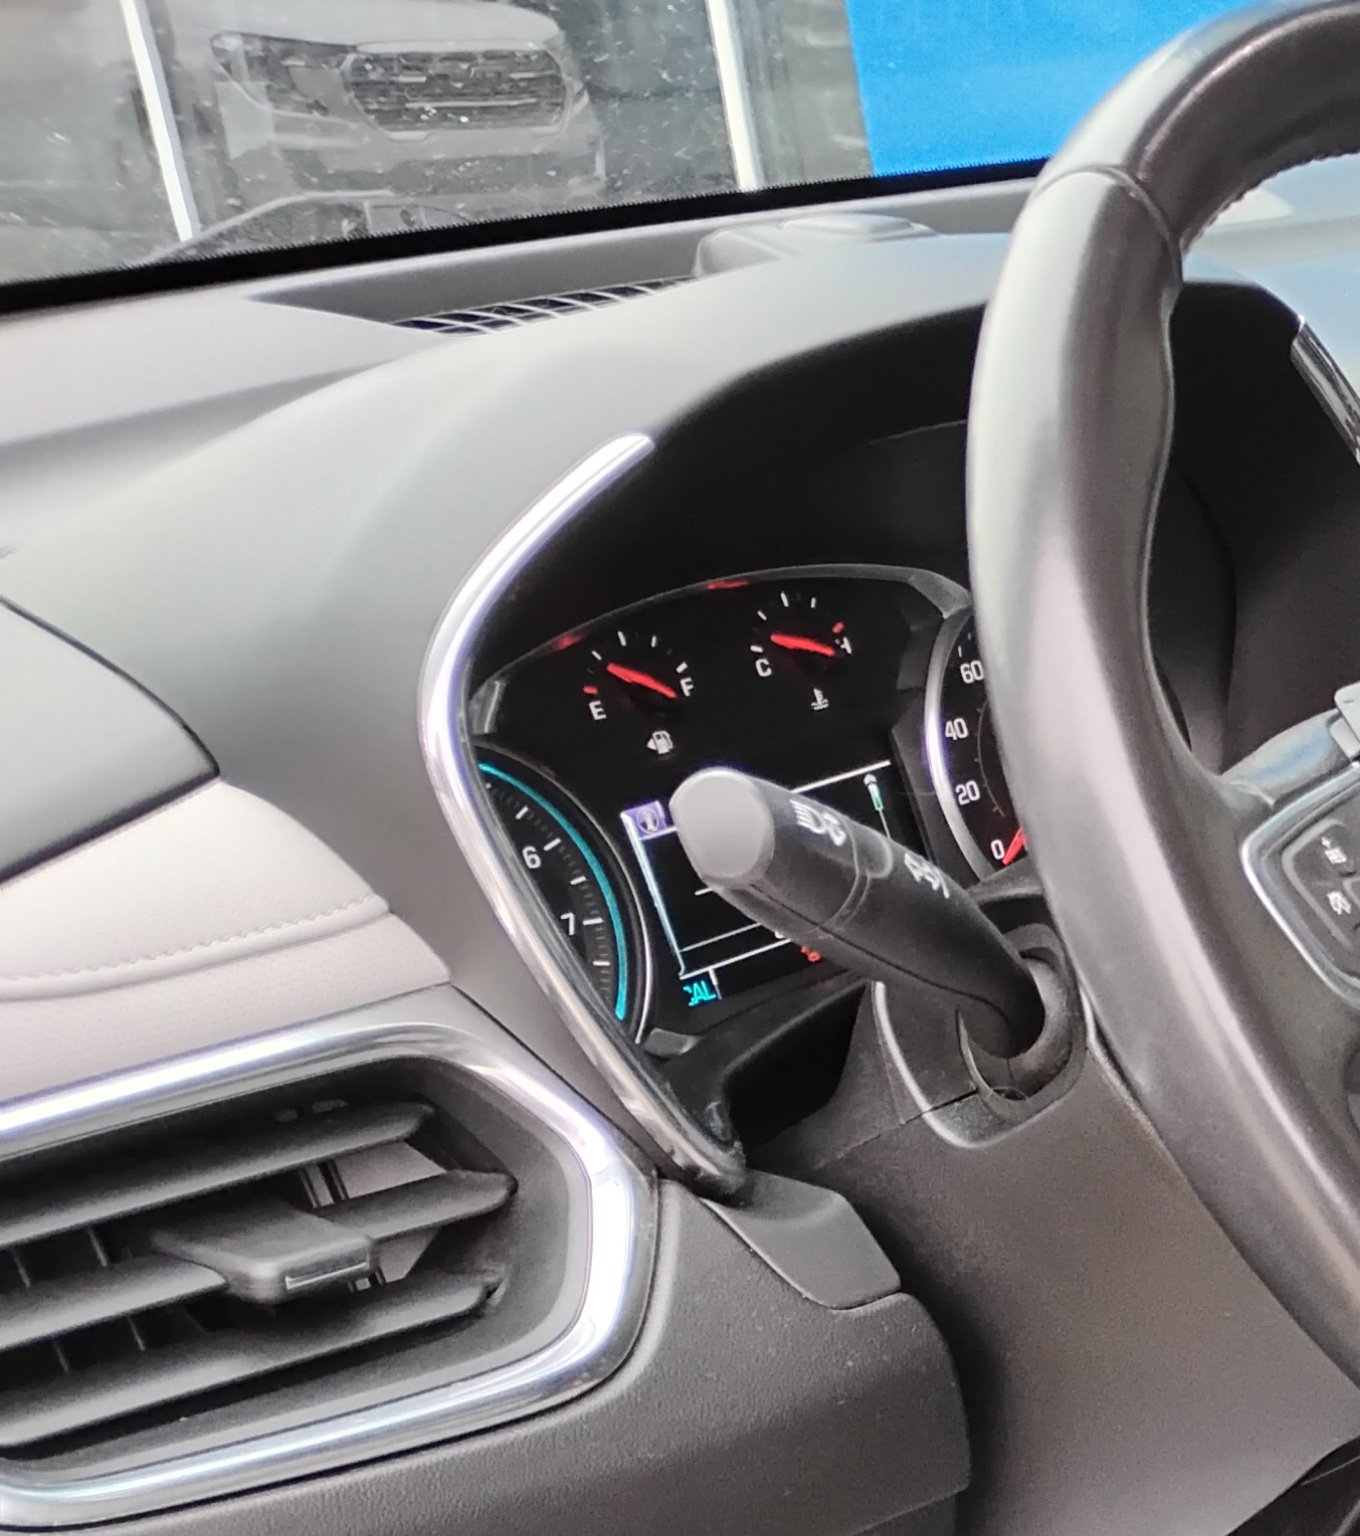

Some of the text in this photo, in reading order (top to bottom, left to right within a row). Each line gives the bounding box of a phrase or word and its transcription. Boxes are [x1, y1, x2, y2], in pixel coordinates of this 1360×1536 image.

[755, 658, 772, 677] C
[960, 660, 984, 684] 60
[680, 677, 694, 697] F
[588, 701, 607, 720] E
[944, 718, 968, 741] 40
[955, 780, 980, 805] 20
[521, 846, 542, 870] 6
[990, 839, 1005, 860] 0
[560, 912, 575, 936] 7
